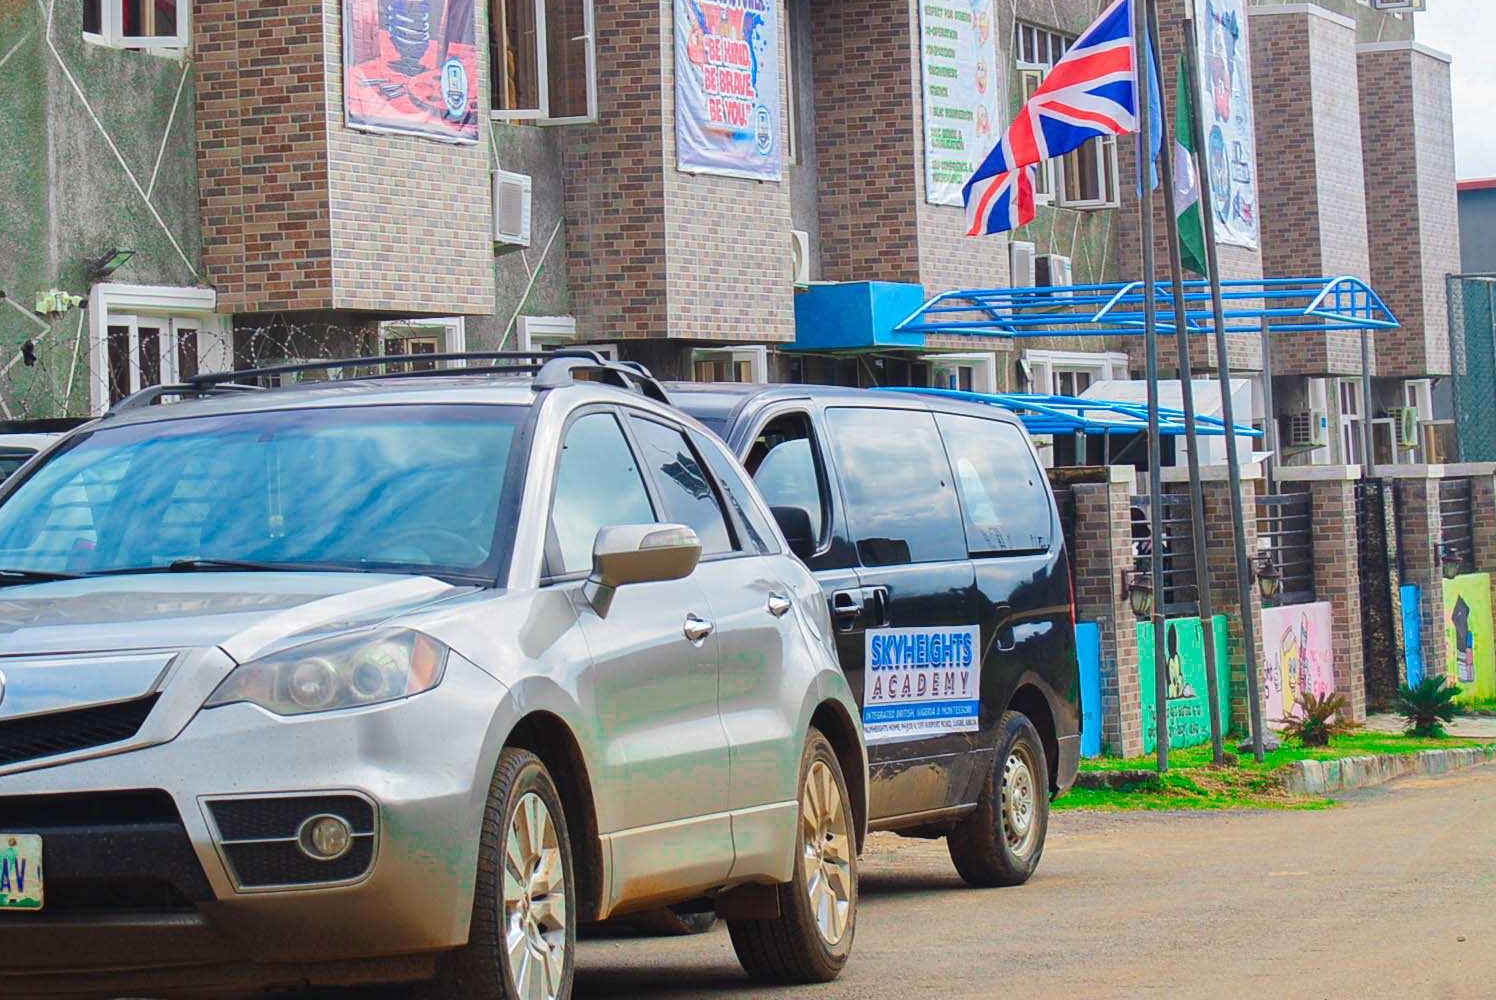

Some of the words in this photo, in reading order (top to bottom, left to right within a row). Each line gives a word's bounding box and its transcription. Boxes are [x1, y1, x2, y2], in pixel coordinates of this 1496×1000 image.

[705, 67, 717, 91] BE
[709, 98, 723, 122] BE
[871, 632, 973, 671] SKYHEIGHTS
[871, 671, 969, 700] ACADEMY
